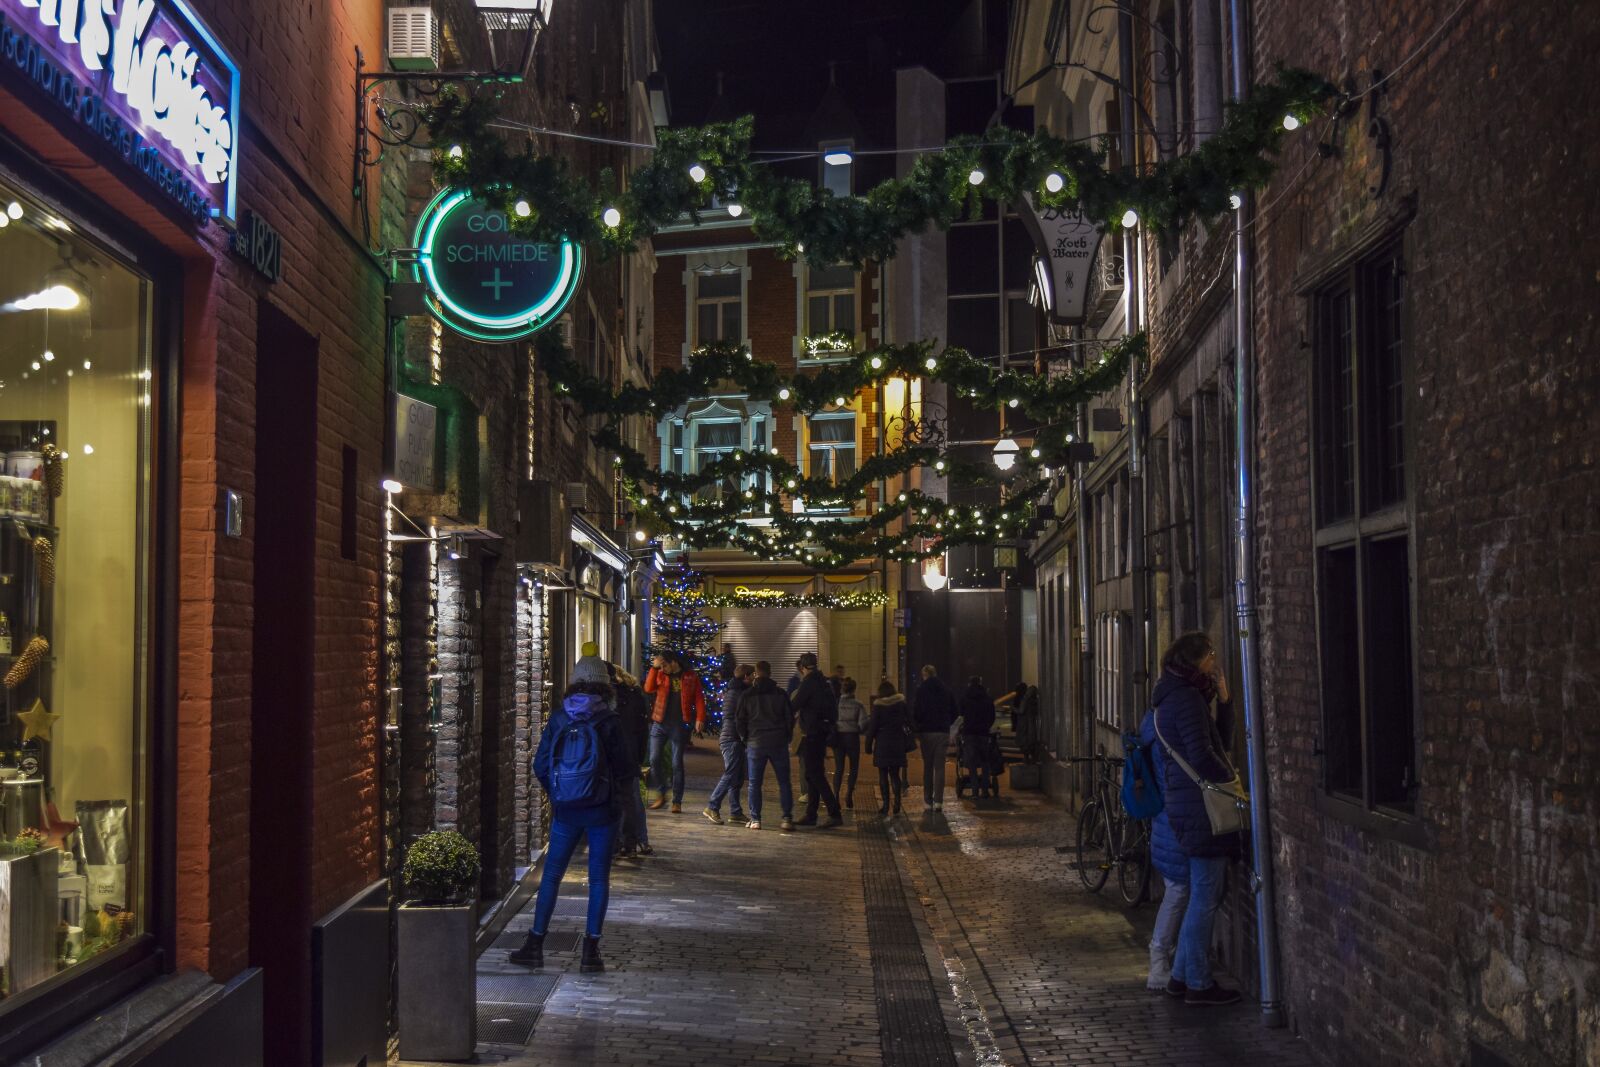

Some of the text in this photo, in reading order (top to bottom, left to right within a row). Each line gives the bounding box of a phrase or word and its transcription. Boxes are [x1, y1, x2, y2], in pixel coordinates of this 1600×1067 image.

[467, 213, 509, 233] GOL
[251, 211, 282, 284] 1820
[1056, 236, 1087, 248] Korb
[447, 244, 548, 263] SCHMIEDE
[1051, 248, 1090, 259] Waren
[409, 403, 433, 430] GOLD
